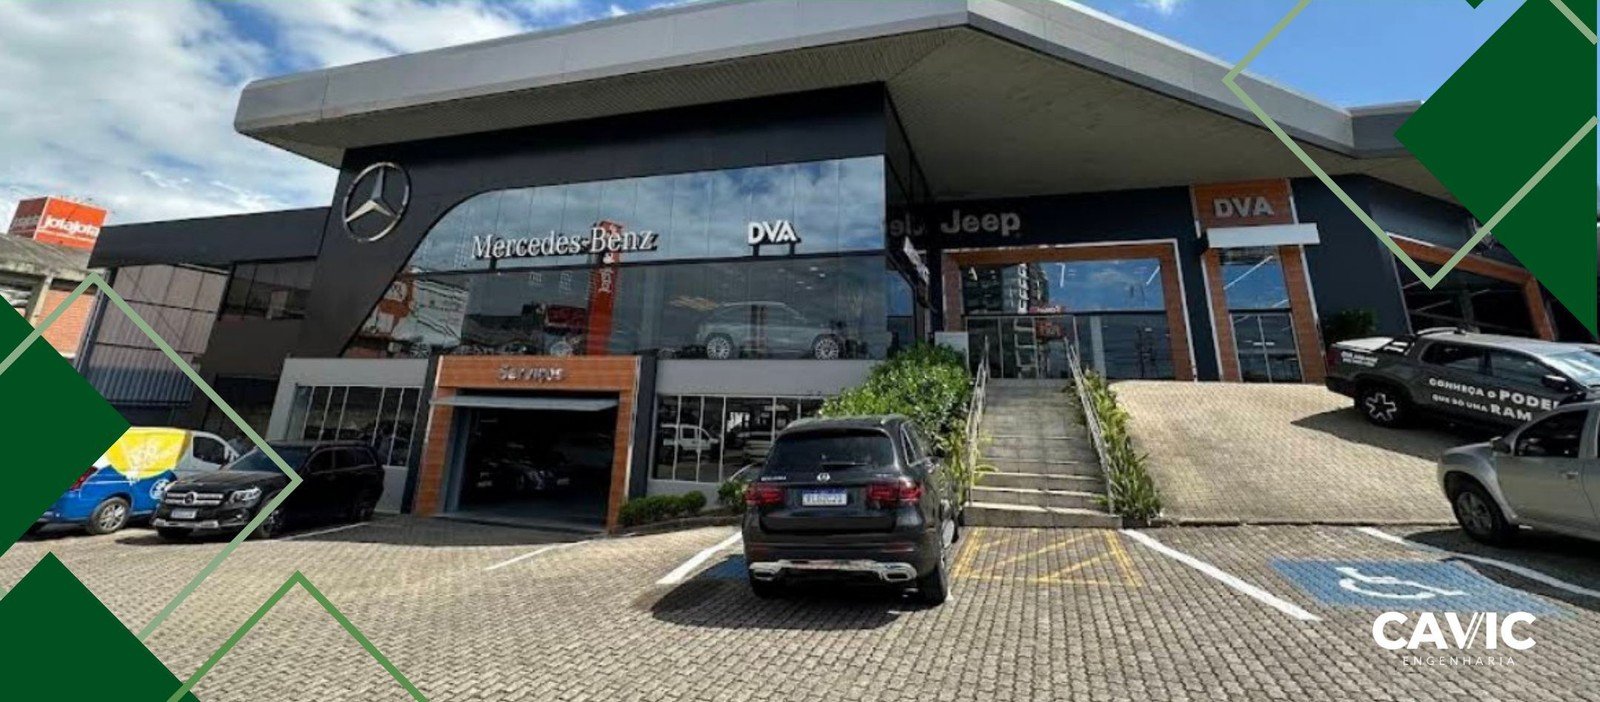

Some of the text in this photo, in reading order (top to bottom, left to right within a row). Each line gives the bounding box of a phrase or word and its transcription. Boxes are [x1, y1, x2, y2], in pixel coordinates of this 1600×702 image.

[1213, 195, 1274, 218] DVA
[747, 219, 798, 244] DVA
[940, 208, 1021, 236] Jeep
[471, 226, 656, 259] Mercedes-Benz
[1429, 377, 1485, 397] CONHEÇA
[1490, 403, 1532, 421] RAM
